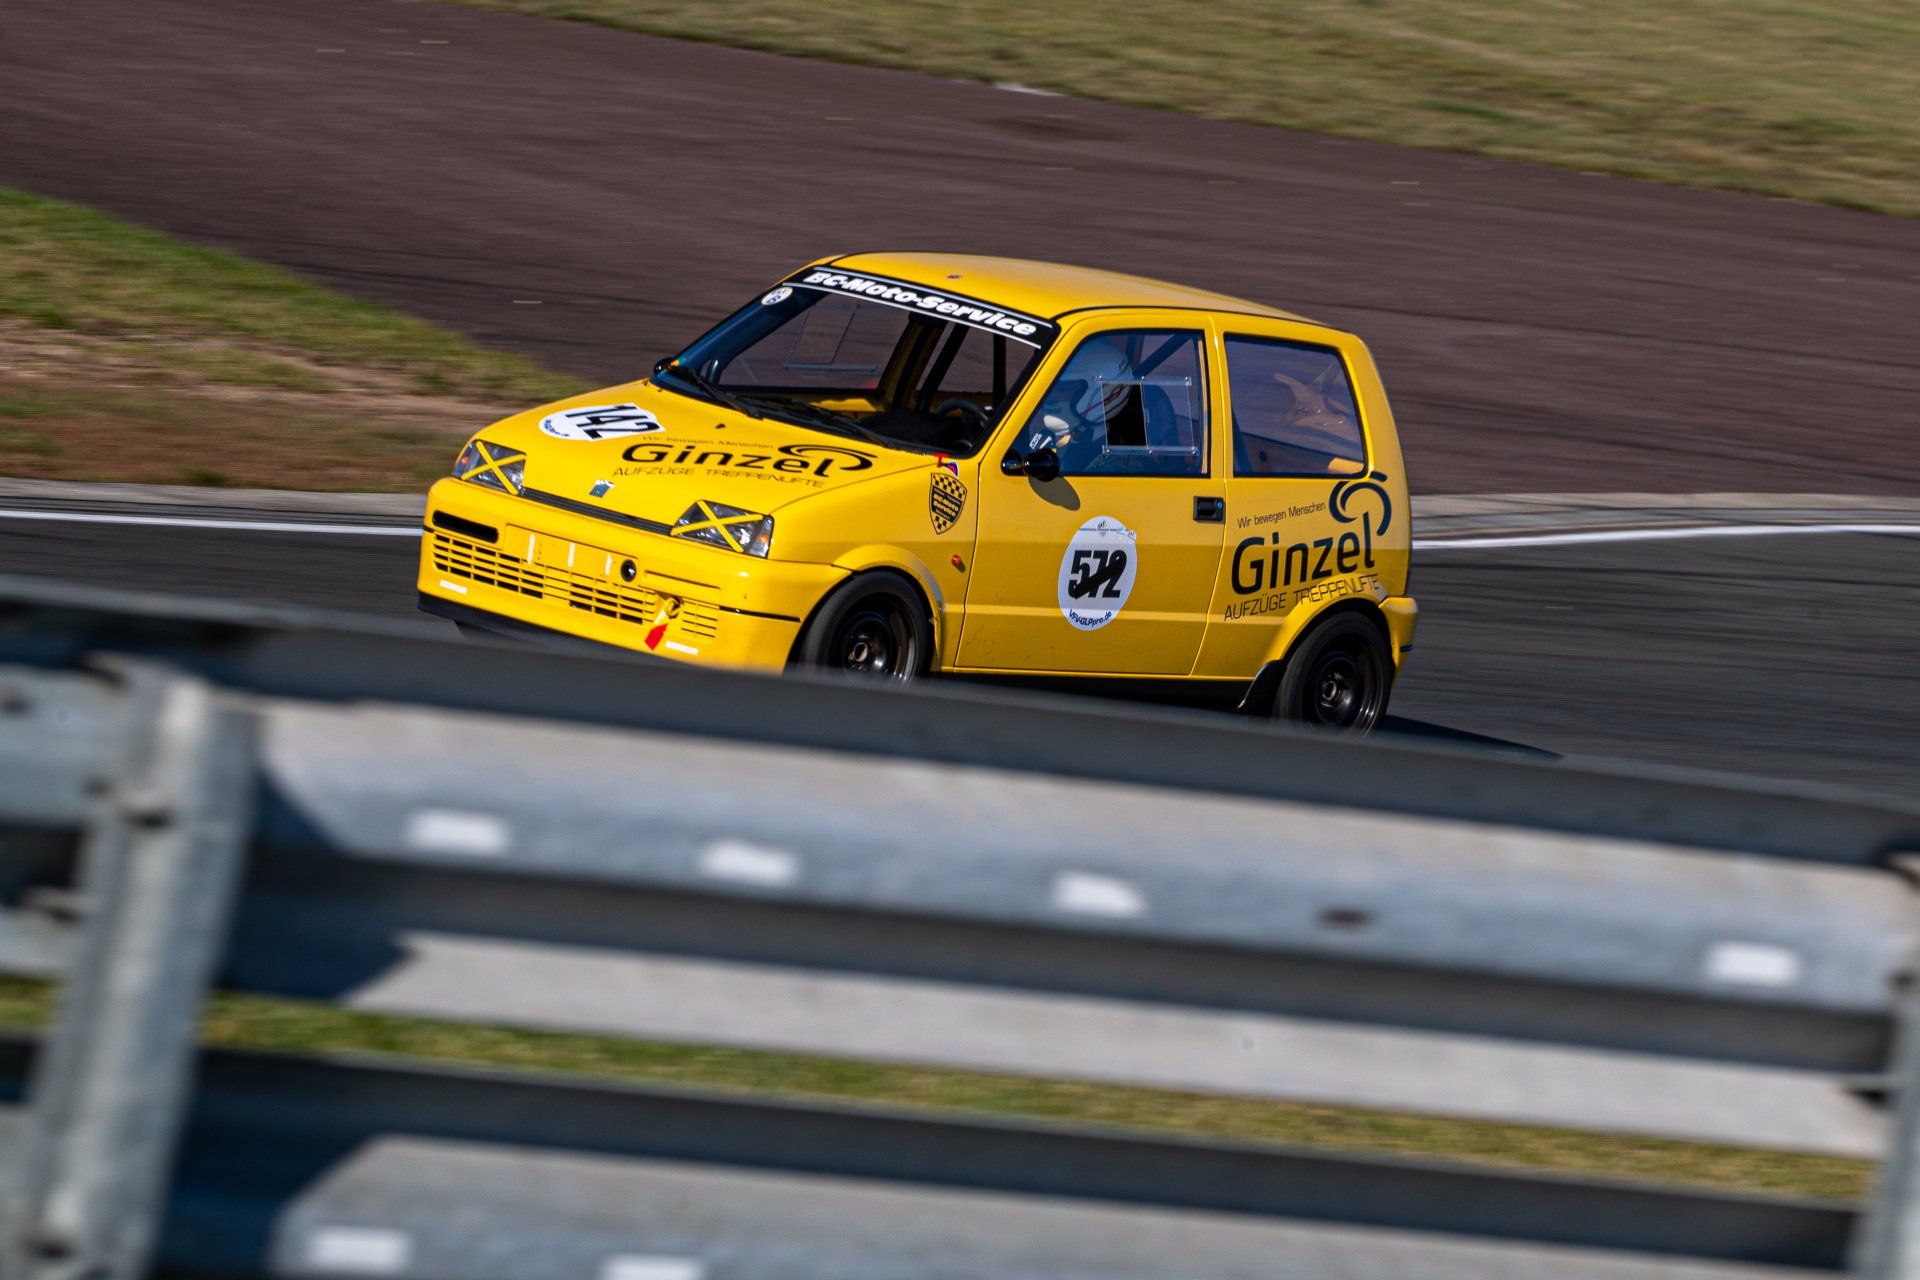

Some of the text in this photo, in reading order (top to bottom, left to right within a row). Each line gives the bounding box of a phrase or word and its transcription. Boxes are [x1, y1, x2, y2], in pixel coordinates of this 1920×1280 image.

[803, 271, 1037, 336] BC-Moto-Service
[565, 405, 660, 439] 142
[622, 443, 834, 478] Ginzel
[1237, 502, 1326, 529] Wir bewegen Menschen
[1231, 511, 1375, 595] Ginzel
[1068, 550, 1127, 600] 572
[1224, 593, 1287, 621] AUFZÜGE
